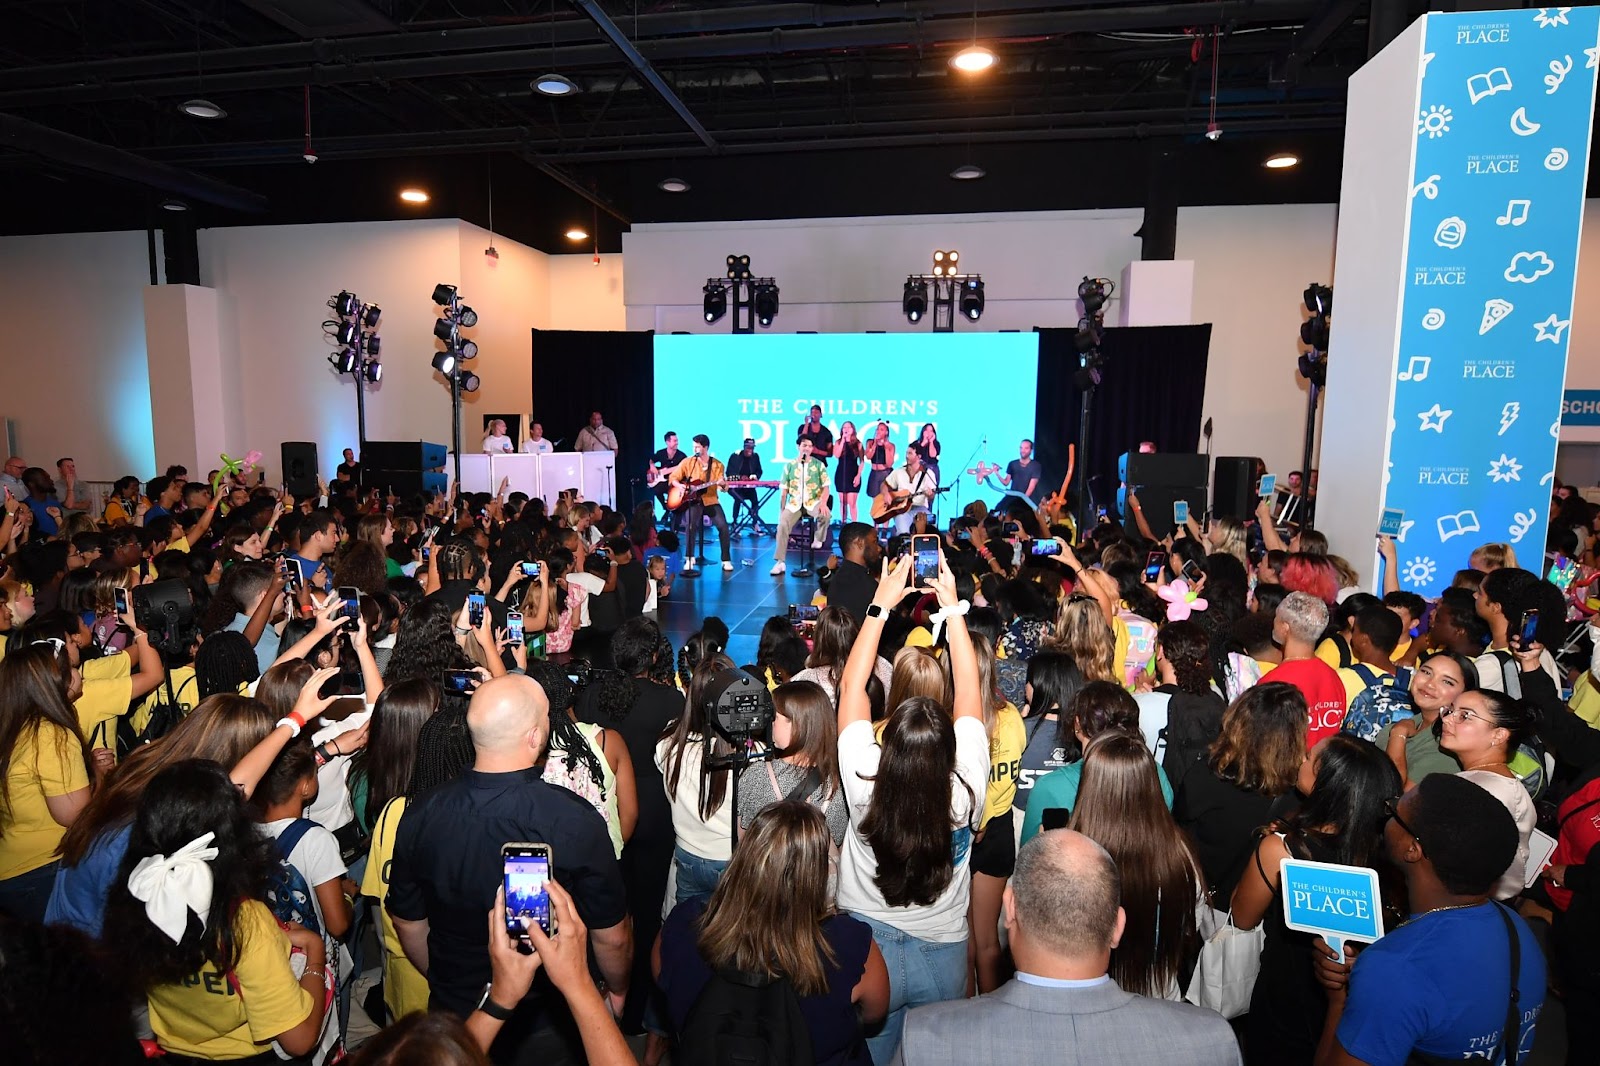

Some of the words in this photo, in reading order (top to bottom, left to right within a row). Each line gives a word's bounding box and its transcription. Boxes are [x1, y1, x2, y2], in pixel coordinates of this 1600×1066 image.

[1456, 29, 1510, 44] PLACE
[1466, 160, 1519, 174] PLACE
[1414, 272, 1466, 285] PLACE
[1463, 365, 1515, 378] PLACE
[737, 399, 783, 414] THE
[793, 399, 939, 415] CHILDREN'S
[1418, 472, 1469, 485] PLACE
[1292, 881, 1309, 890] THE
[1312, 885, 1366, 898] CHILDREN'S
[1293, 890, 1370, 919] PLACE
[1469, 1030, 1498, 1048] THE
